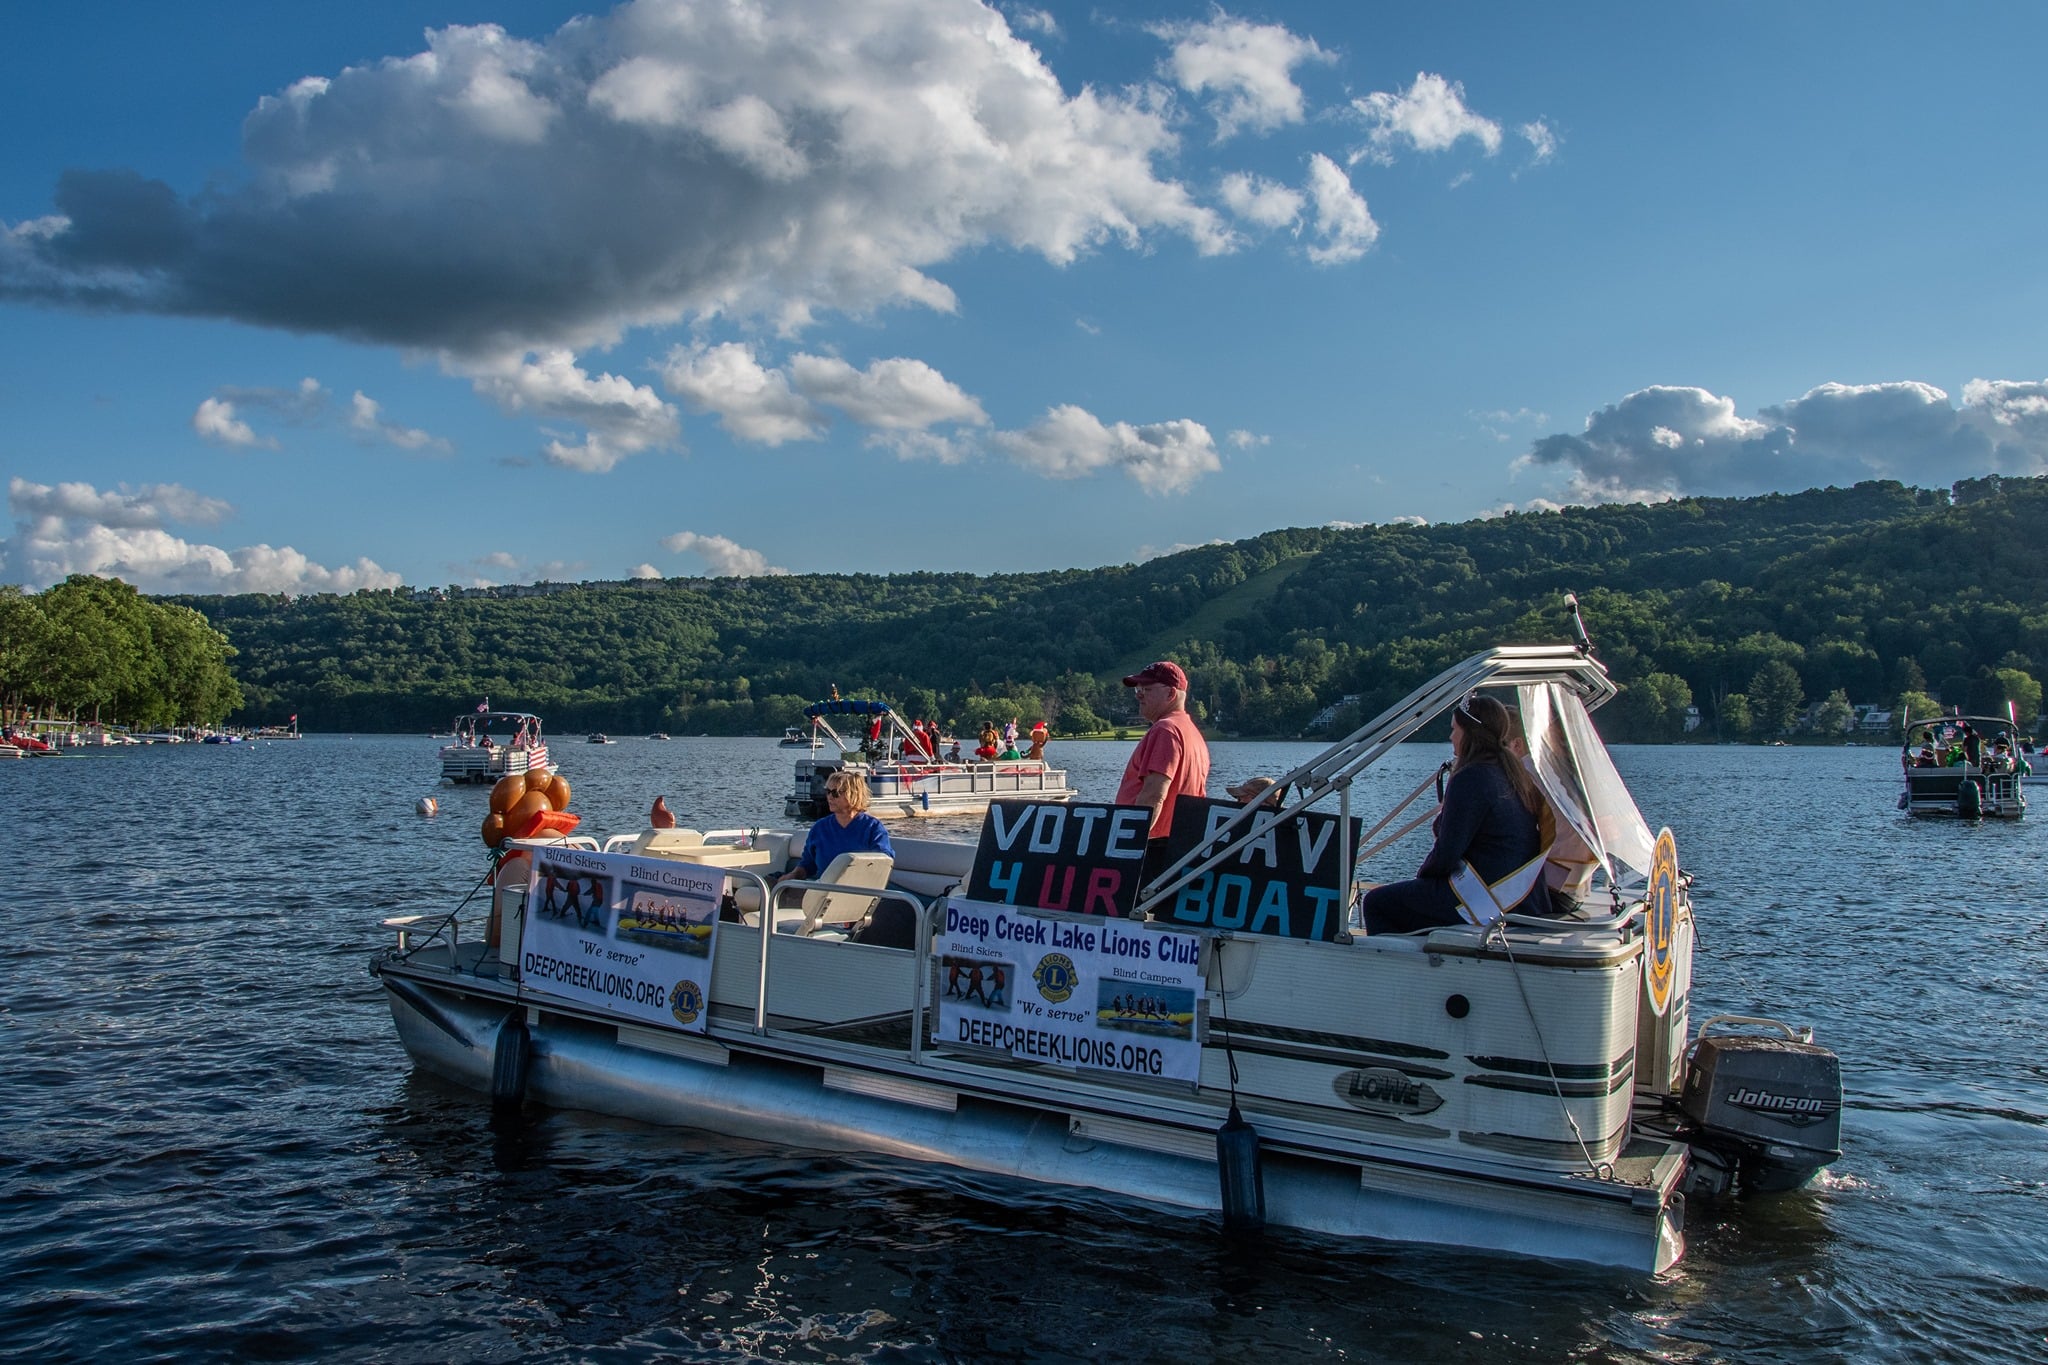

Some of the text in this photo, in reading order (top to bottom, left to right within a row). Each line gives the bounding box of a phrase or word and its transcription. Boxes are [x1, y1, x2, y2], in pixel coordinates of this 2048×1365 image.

[991, 804, 1149, 861] VOTE
[1202, 805, 1335, 874] FAV
[545, 848, 607, 871] Blind Skiers
[630, 866, 713, 893] Blind Campers
[989, 860, 1122, 918] 4 UR
[1173, 866, 1342, 941] BOAT
[1657, 886, 1668, 950] L
[946, 908, 1200, 966] Deep Creek Lake Lions Club
[951, 942, 1003, 959] Blind Skiers
[578, 939, 645, 967] "We serve"
[1044, 954, 1071, 968] LIONS
[525, 952, 665, 1008] DEEPCREEKLIONS.ORG
[677, 982, 699, 994] LIONS
[1050, 968, 1062, 987] L
[1112, 967, 1182, 985] Blind Campers
[682, 993, 691, 1010] L
[1016, 1000, 1090, 1024] "We serve"
[959, 1017, 1163, 1076] DEEPCREEKLIONS.ORG
[1349, 1071, 1419, 1104] LOWE
[1728, 1088, 1823, 1112] Johnson
